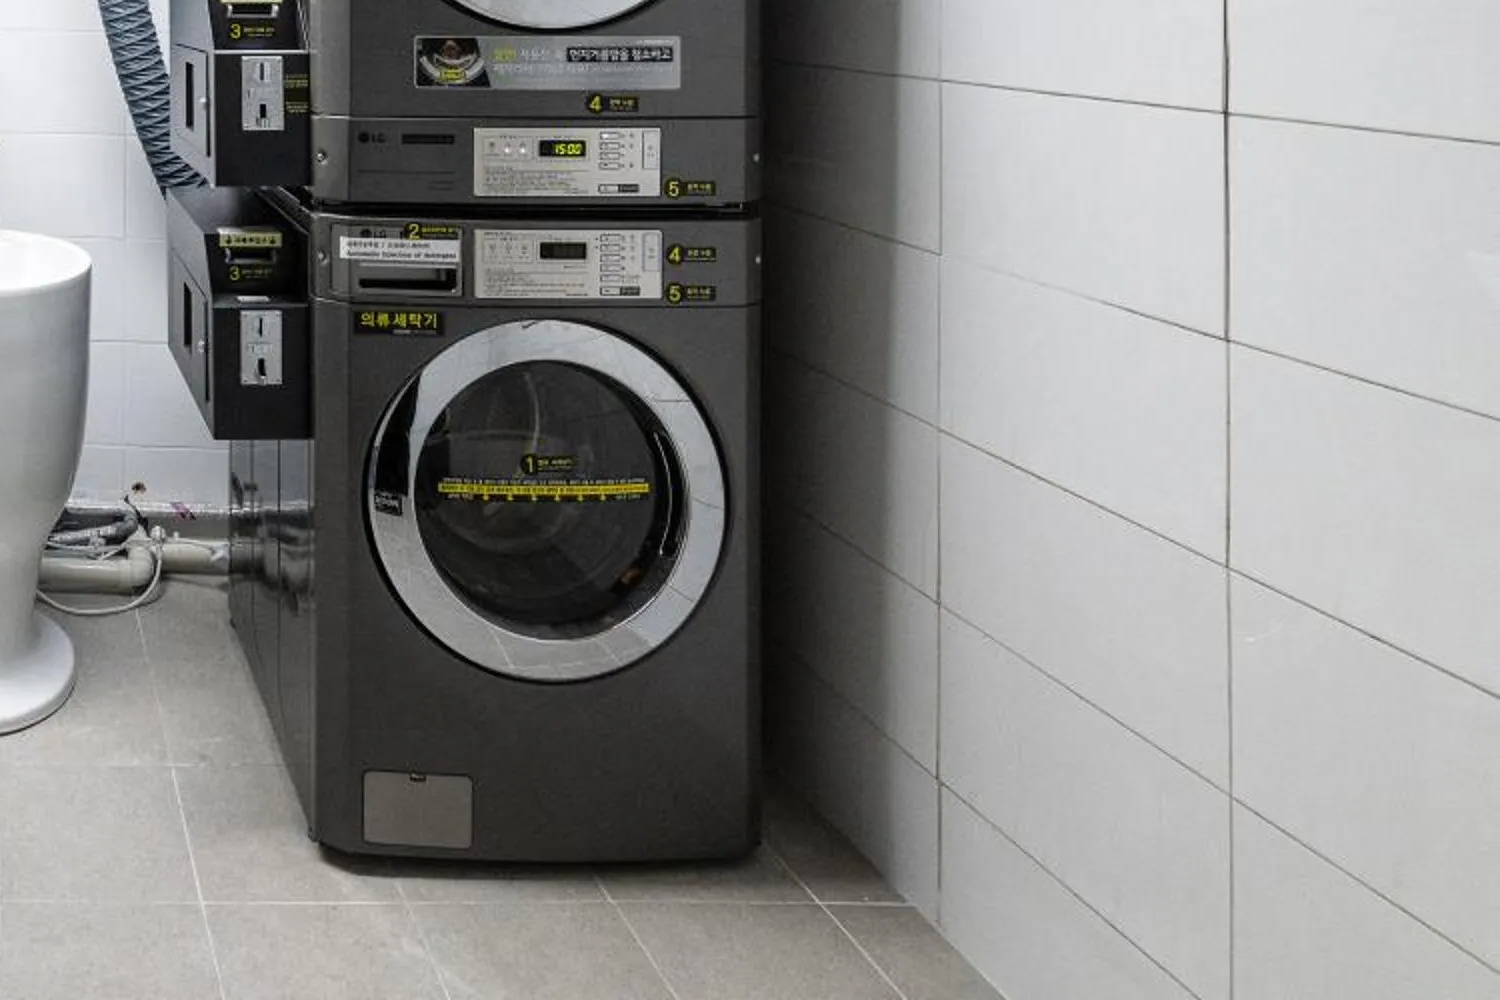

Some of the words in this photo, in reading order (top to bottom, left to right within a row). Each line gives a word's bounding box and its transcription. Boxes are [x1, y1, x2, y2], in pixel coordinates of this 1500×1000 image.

[230, 23, 241, 39] 3
[589, 95, 601, 110] 4
[669, 181, 679, 196] 5
[409, 223, 420, 240] 2
[669, 247, 680, 262] 4
[229, 266, 240, 281] 3
[669, 286, 681, 302] 5
[360, 311, 437, 329] 의류세탁기
